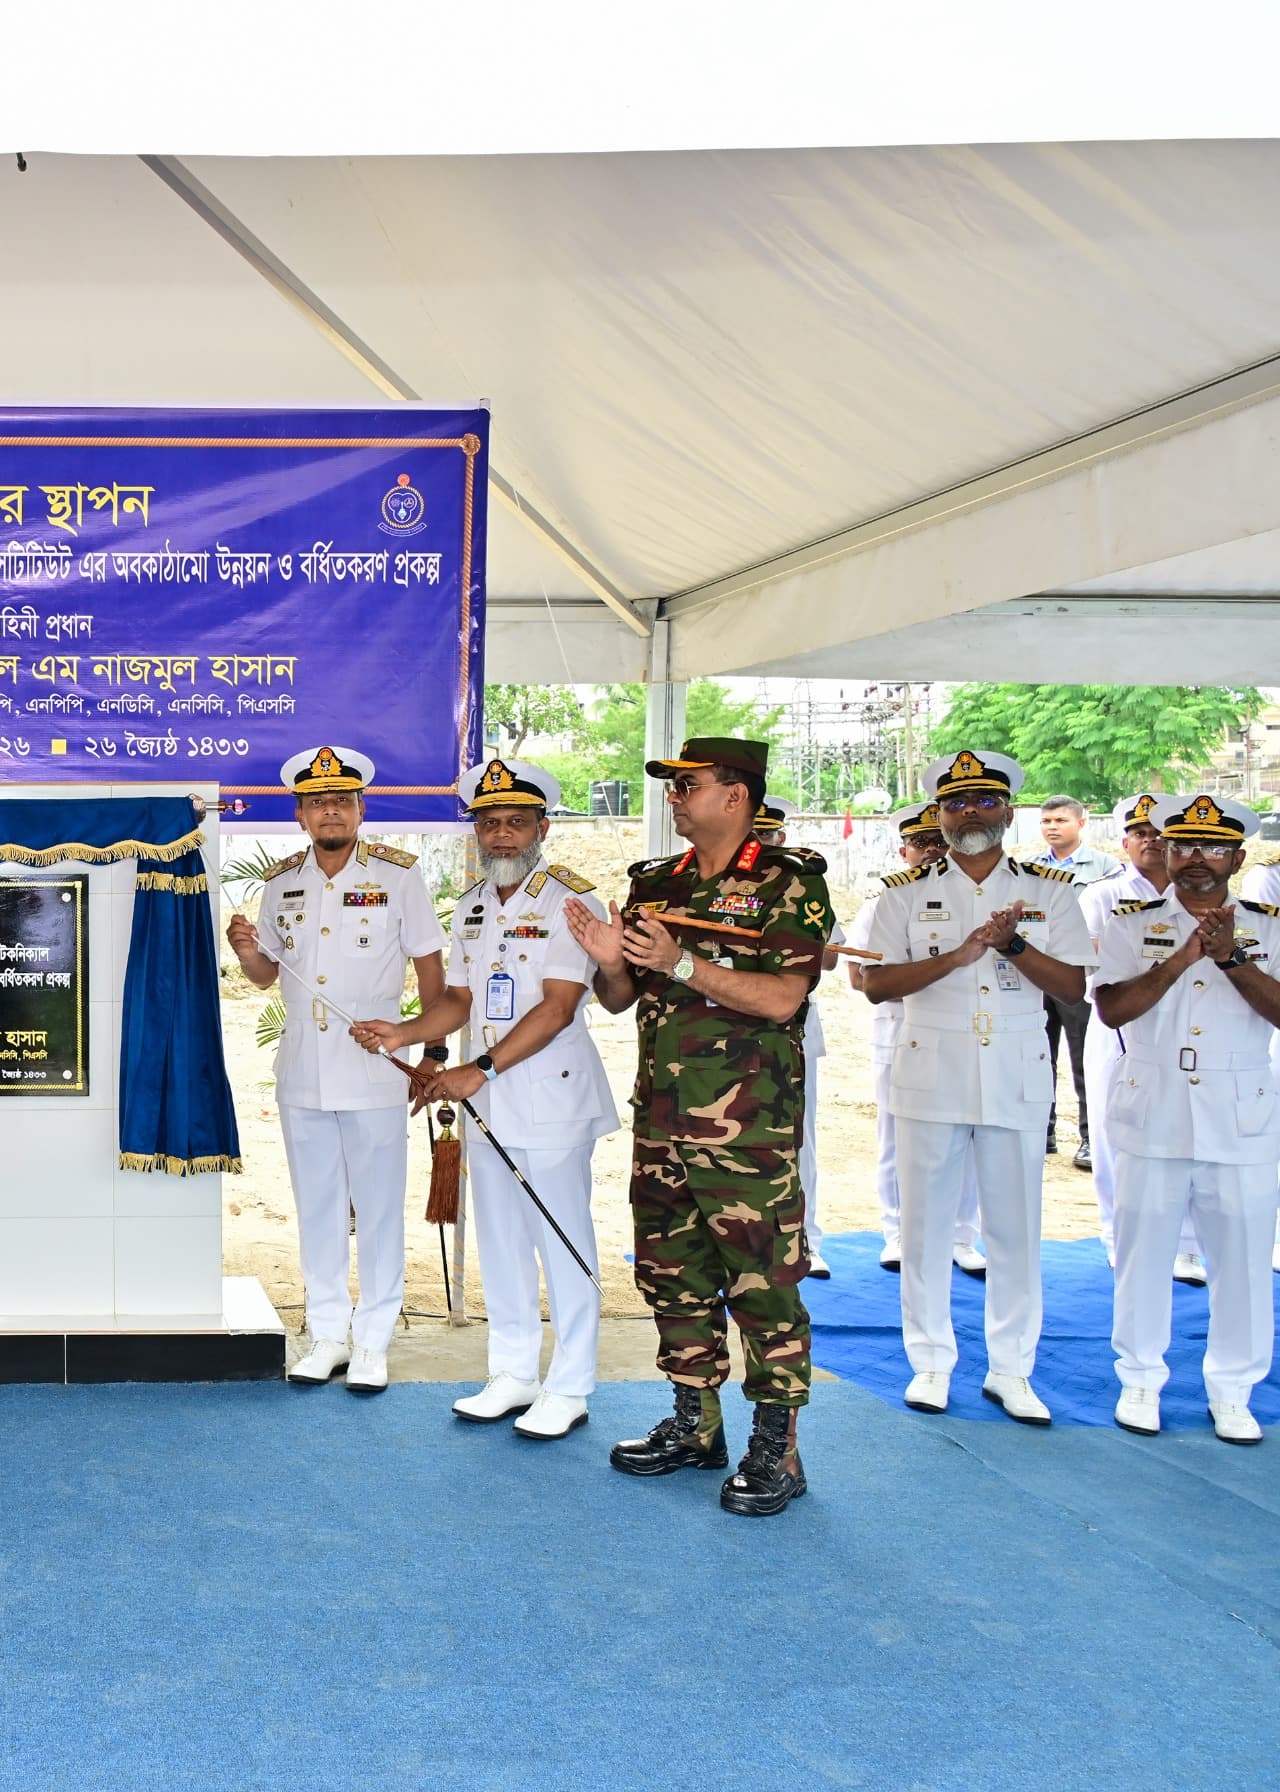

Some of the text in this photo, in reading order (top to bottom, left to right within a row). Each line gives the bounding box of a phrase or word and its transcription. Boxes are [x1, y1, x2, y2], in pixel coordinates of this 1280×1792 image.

[38, 481, 156, 537] স্থাপন
[78, 552, 109, 583] এর
[110, 538, 211, 584] অবকাঠামো
[214, 541, 272, 589] উন্নয়ন
[277, 554, 293, 581] ও
[298, 540, 390, 584] বর্ধিতকরণ
[393, 550, 443, 588] প্রকল্প
[45, 613, 94, 642] প্রধান
[31, 655, 82, 685] এম
[91, 653, 199, 694] নাজমুল
[207, 653, 299, 687] হাসান
[236, 693, 297, 714] পিএসসি
[84, 736, 117, 759] ২৬
[123, 727, 181, 758] জ্যৈষ্ঠ
[187, 736, 249, 757] ১৪৩৩
[45, 972, 72, 989] প্রকল্প
[5, 1030, 48, 1048] হাসান
[22, 1050, 48, 1060] পিএসসি
